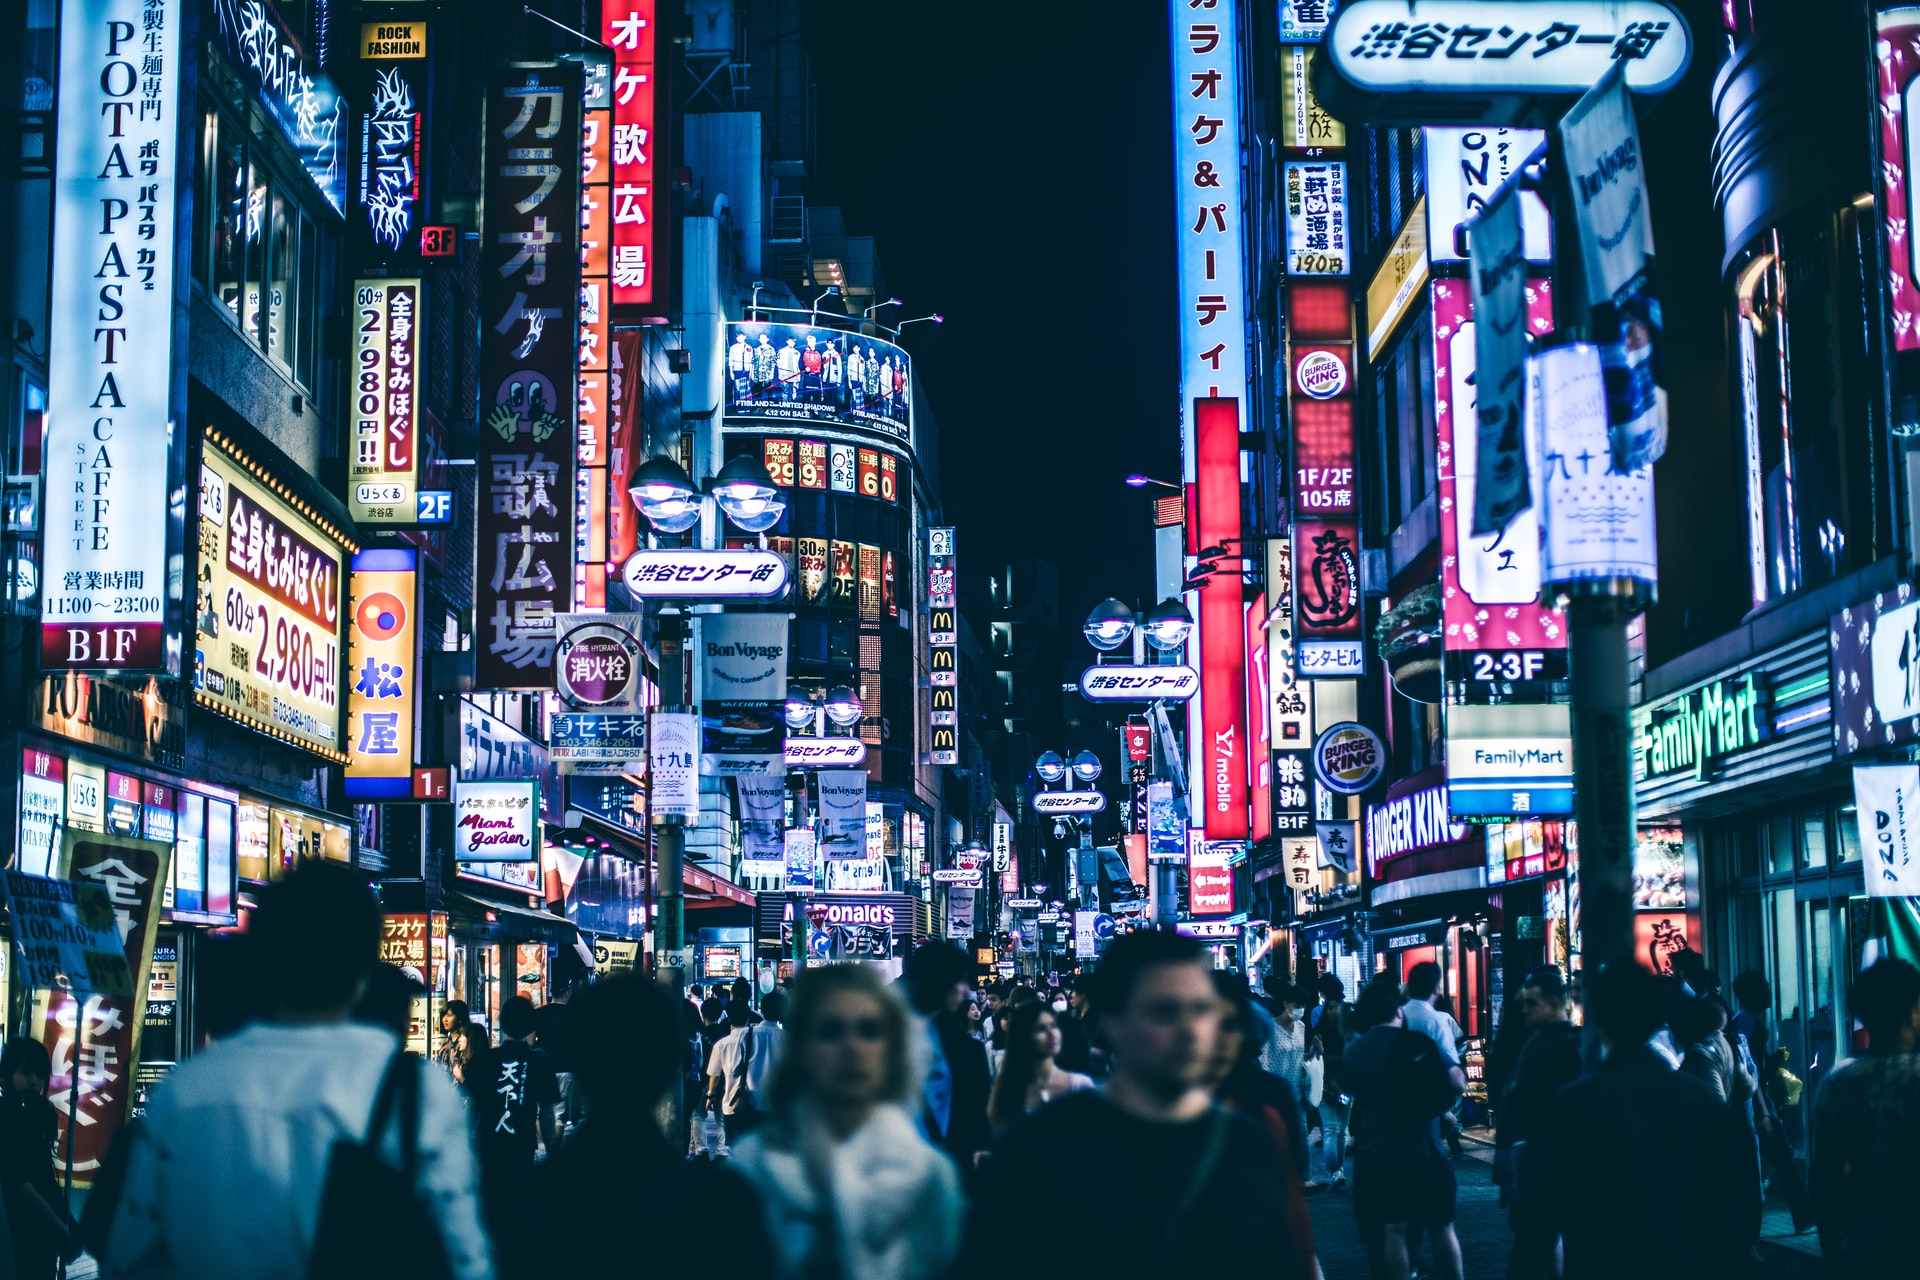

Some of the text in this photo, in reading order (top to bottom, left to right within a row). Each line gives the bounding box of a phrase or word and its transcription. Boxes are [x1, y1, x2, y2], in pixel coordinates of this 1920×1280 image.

[377, 26, 411, 40] ROCK
[1349, 21, 1671, 60] 渋谷センター街
[367, 41, 420, 56] FASHION
[1296, 55, 1305, 135] TORIKIZOKU
[1306, 148, 1323, 156] 4F
[1187, 0, 1228, 398] ラオケ&パーティ
[425, 229, 455, 253] 3F
[1295, 254, 1343, 273] 190円
[90, 21, 137, 551] POTA PASTA CAFFE
[357, 287, 383, 306] 60分
[388, 291, 414, 467] 全身もみほぐし
[1304, 361, 1338, 377] BURGER
[1306, 369, 1339, 388] KING
[735, 399, 770, 408] FTISLAND
[1297, 467, 1353, 487] 1F/2F
[72, 442, 86, 551] STREET
[360, 488, 401, 500] りらくる
[1300, 488, 1351, 508] 105席
[367, 507, 394, 518] 渋谷店
[418, 495, 451, 520] 2F
[800, 541, 826, 556] 30分
[229, 497, 337, 623] 全身もみほぐし
[63, 570, 144, 591] 営業時間
[633, 563, 779, 583] 渋谷センター街
[226, 587, 255, 633] 60分
[66, 628, 137, 662] B1F
[575, 645, 590, 653] FIRE
[590, 643, 620, 652] HYDRANT
[707, 642, 784, 661] Bon Voyage
[1299, 649, 1362, 667] センタービル
[570, 655, 627, 682] 消火栓
[1088, 675, 1194, 690] 渋谷センター街
[355, 655, 405, 756] 松屋
[1639, 671, 1760, 783] FamilyMart
[567, 737, 636, 747] 03-3464-2061
[1325, 738, 1374, 760] BURGER
[552, 747, 570, 758] 買取
[1327, 749, 1376, 776] KING
[1475, 749, 1564, 767] FamilyMart
[72, 782, 97, 808] りらくる
[757, 787, 784, 798] Voyage
[821, 786, 865, 798] Bon Voyage
[1036, 796, 1101, 808] 渋谷センター街
[1511, 792, 1530, 812] 酒
[459, 797, 530, 810] パスタとピザ
[458, 814, 514, 829] Miami
[1277, 817, 1309, 829] B1F
[1373, 797, 1414, 861] BURGER
[1327, 828, 1348, 869] 寿司
[1292, 845, 1311, 885] 寿司
